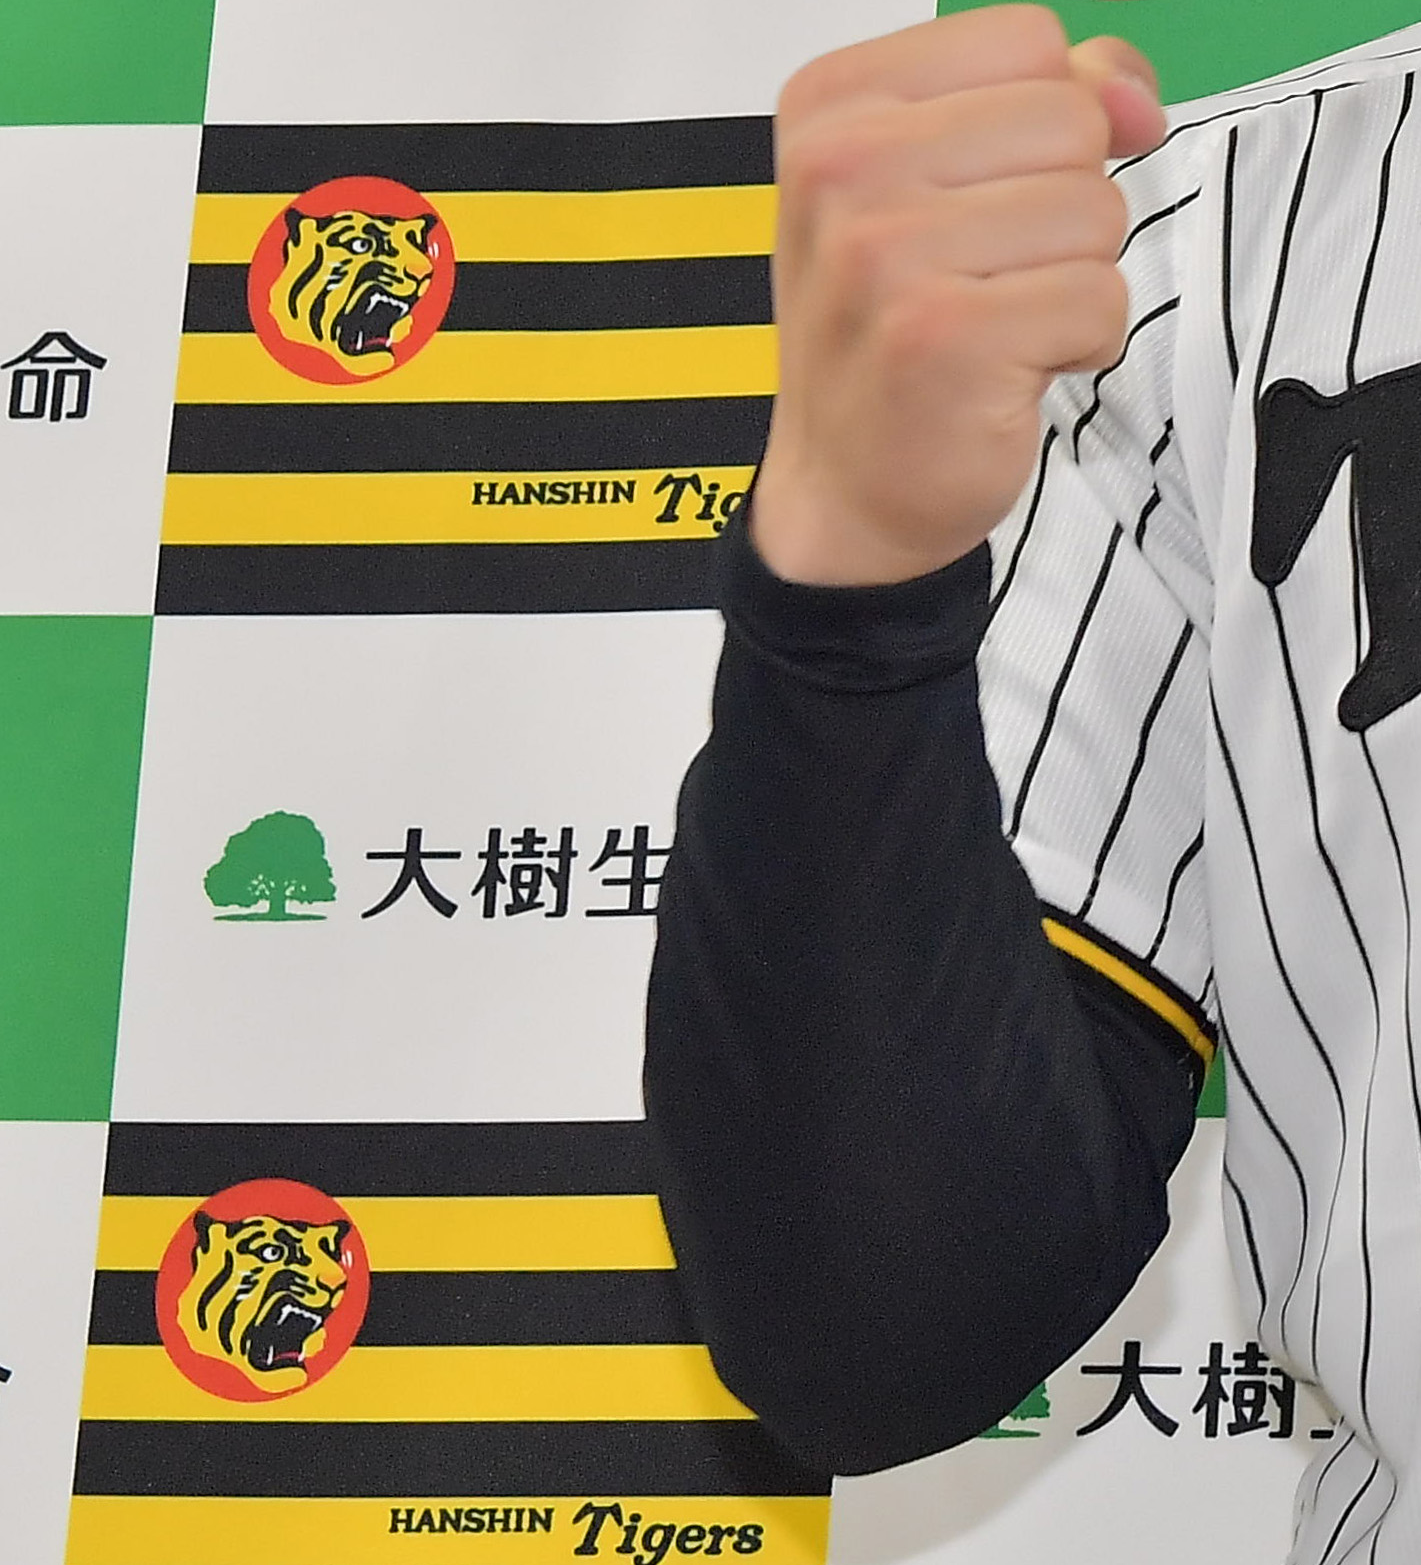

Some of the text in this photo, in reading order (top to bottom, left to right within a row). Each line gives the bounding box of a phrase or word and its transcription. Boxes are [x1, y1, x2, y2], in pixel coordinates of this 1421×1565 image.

[472, 479, 637, 507] HANSHIN
[388, 1501, 765, 1565] HANSHIN Tigers
